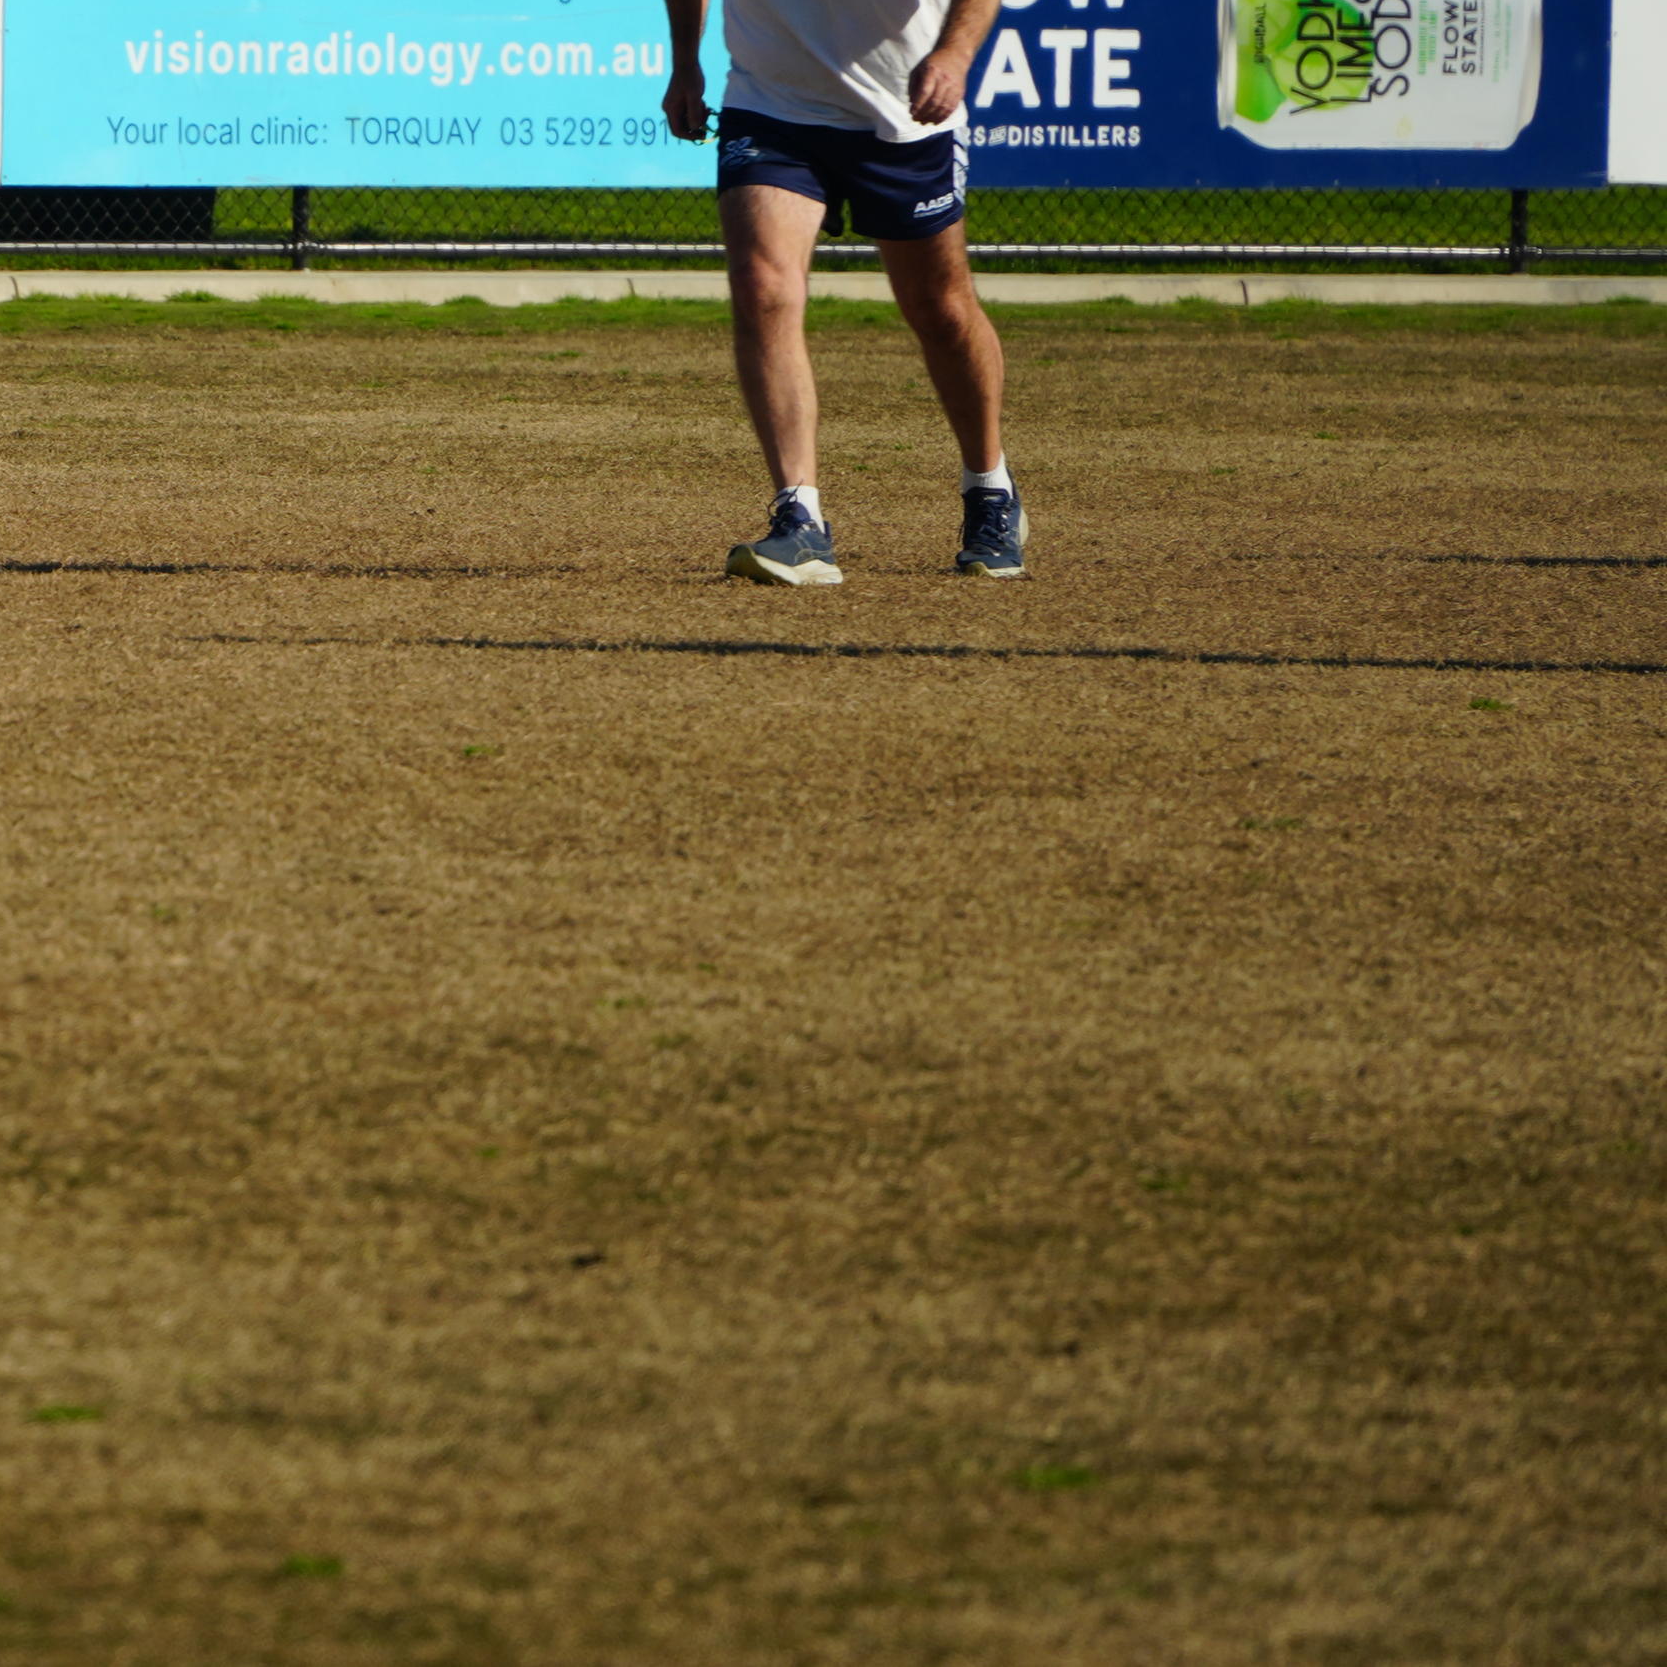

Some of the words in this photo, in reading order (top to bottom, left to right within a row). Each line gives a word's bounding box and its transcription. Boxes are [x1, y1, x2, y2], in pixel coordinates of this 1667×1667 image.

[125, 30, 664, 86] visionradiology.com.au
[975, 29, 1141, 108] ATE
[1330, 9, 1374, 103] LIME
[1443, 0, 1459, 75] FLOW
[1462, 0, 1478, 75] STATE
[107, 117, 168, 144] Your
[179, 117, 240, 145] local
[251, 117, 327, 145] clinic:
[345, 117, 481, 146] TORQUAY
[501, 117, 533, 146] 03
[546, 117, 611, 146] 5292
[623, 117, 681, 146] 991
[1008, 125, 1141, 147] DISTILLERS
